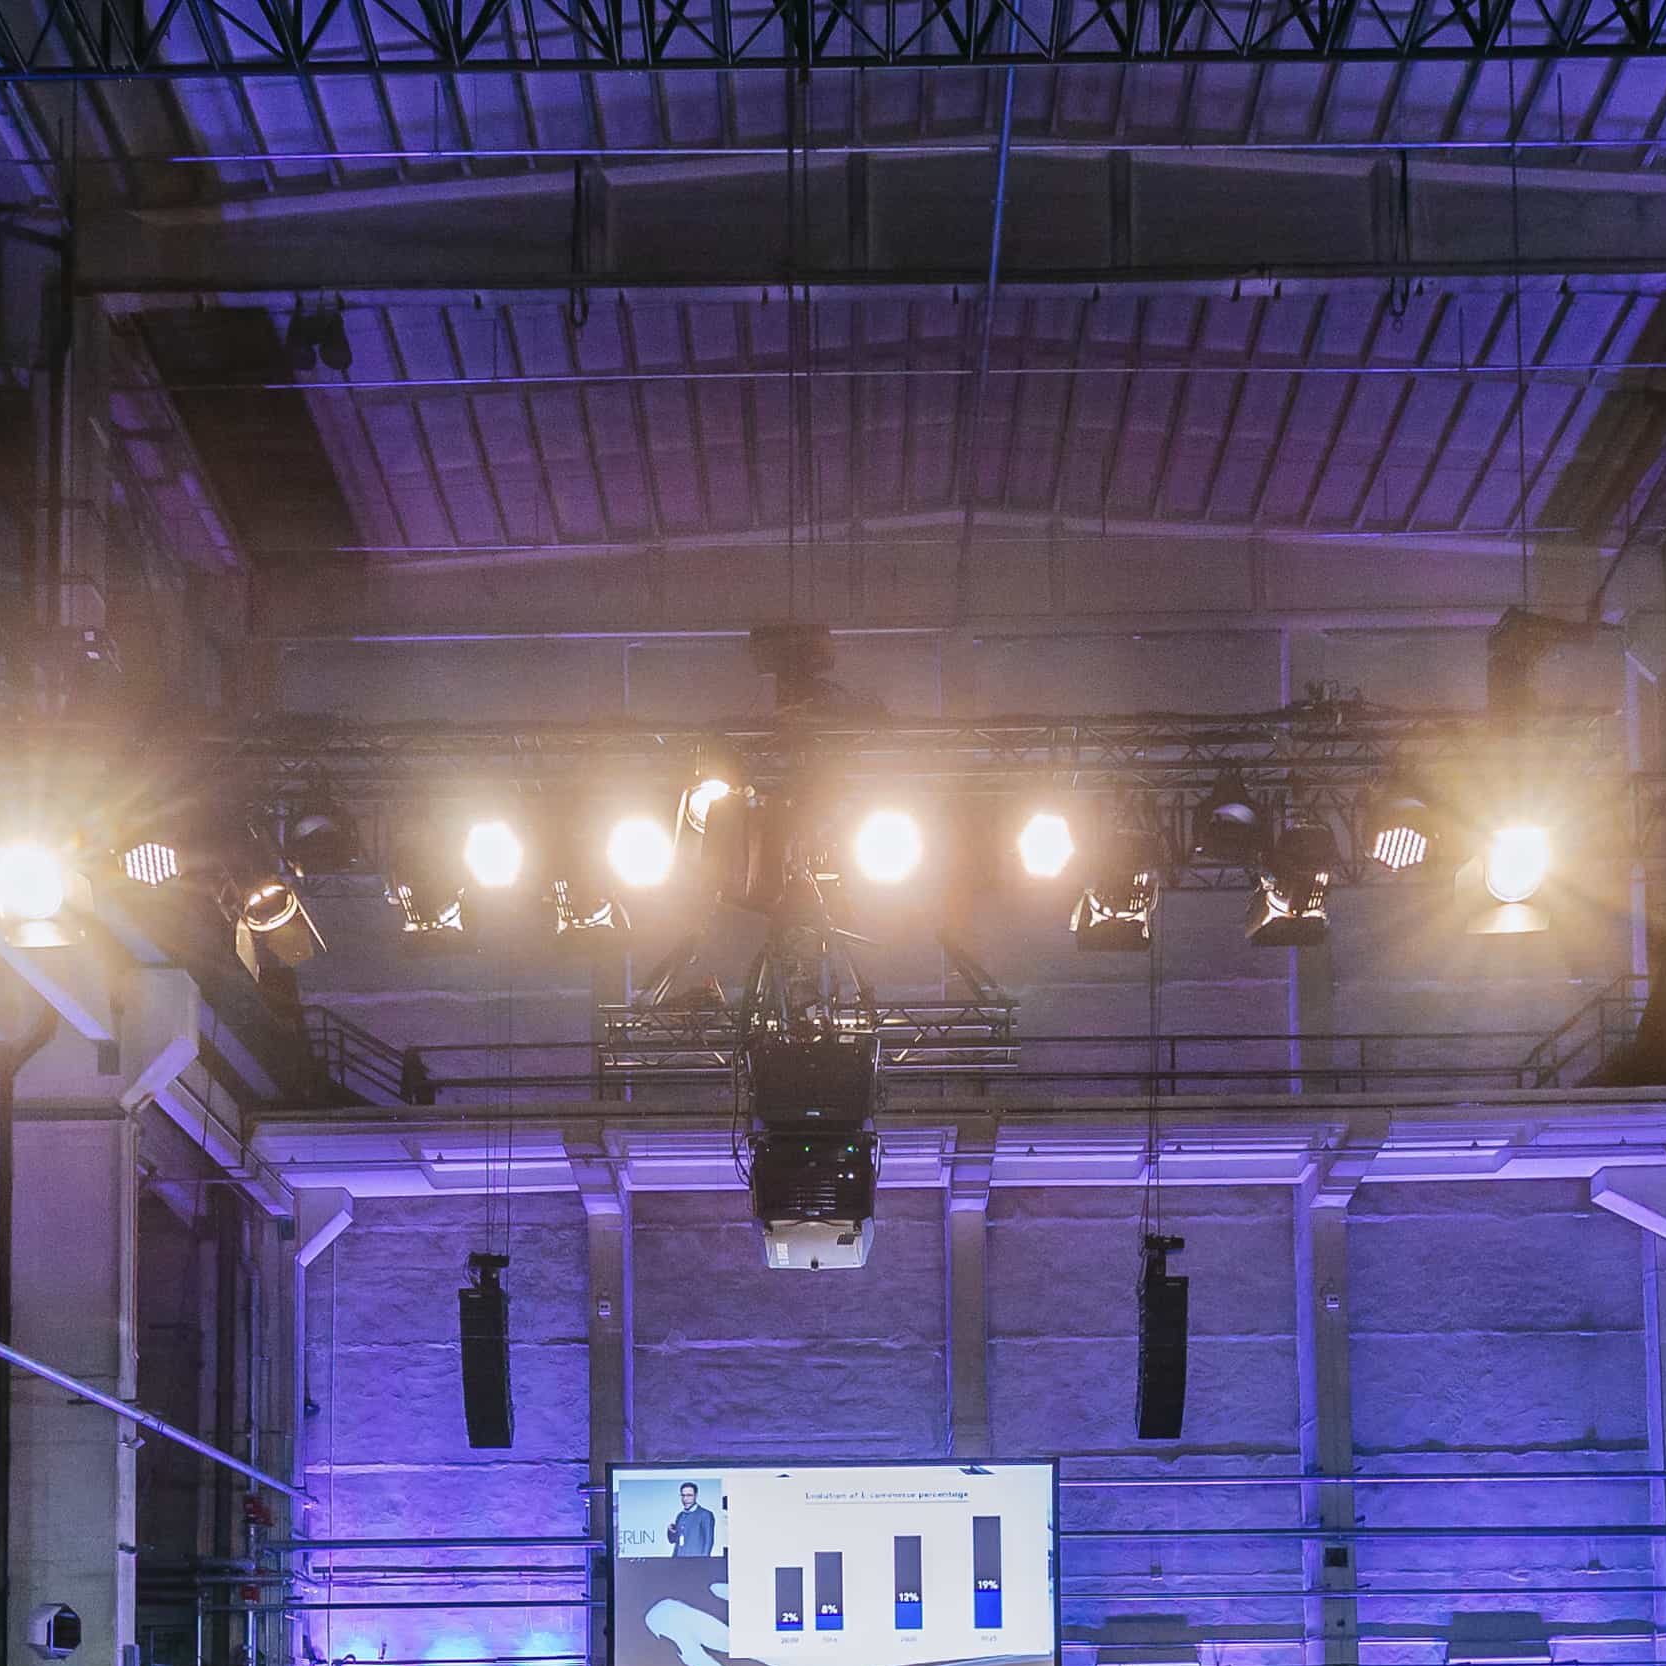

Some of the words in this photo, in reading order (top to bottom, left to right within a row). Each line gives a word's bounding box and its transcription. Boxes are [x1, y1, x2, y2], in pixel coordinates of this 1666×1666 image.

[978, 1580, 999, 1590] 19%
[898, 1592, 919, 1602] 12%
[821, 1605, 838, 1614] 8%
[782, 1612, 799, 1622] 2%
